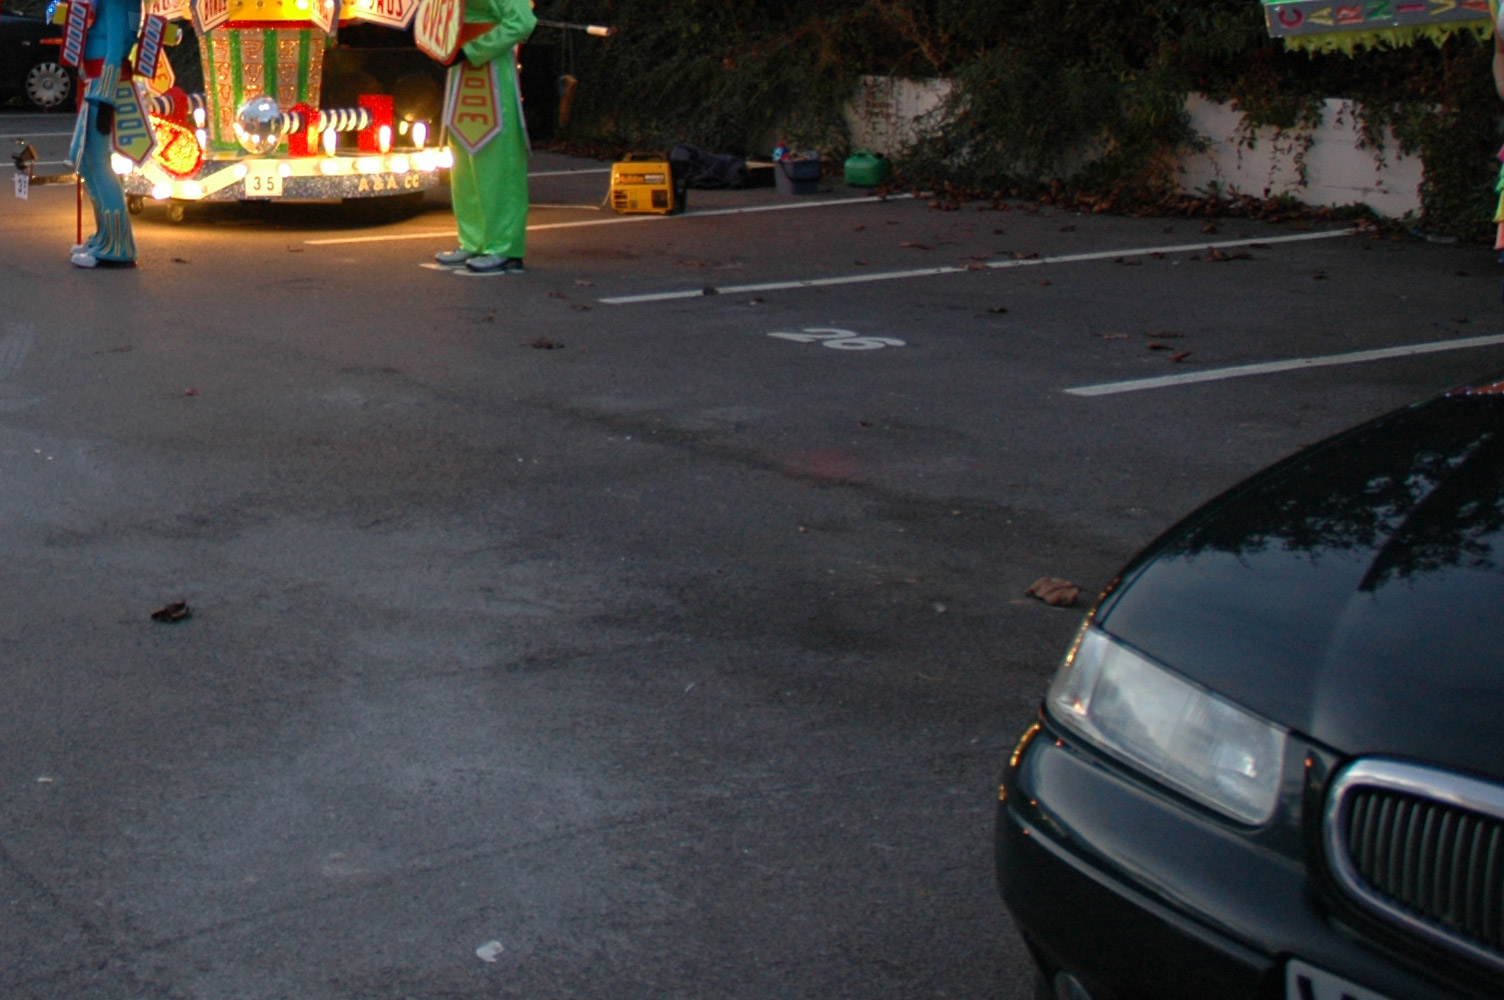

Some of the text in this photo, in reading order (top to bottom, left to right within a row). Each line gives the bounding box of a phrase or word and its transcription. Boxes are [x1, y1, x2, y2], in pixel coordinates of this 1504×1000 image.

[115, 86, 147, 146] 9000
[253, 176, 275, 192] 35
[766, 327, 907, 351] 26
